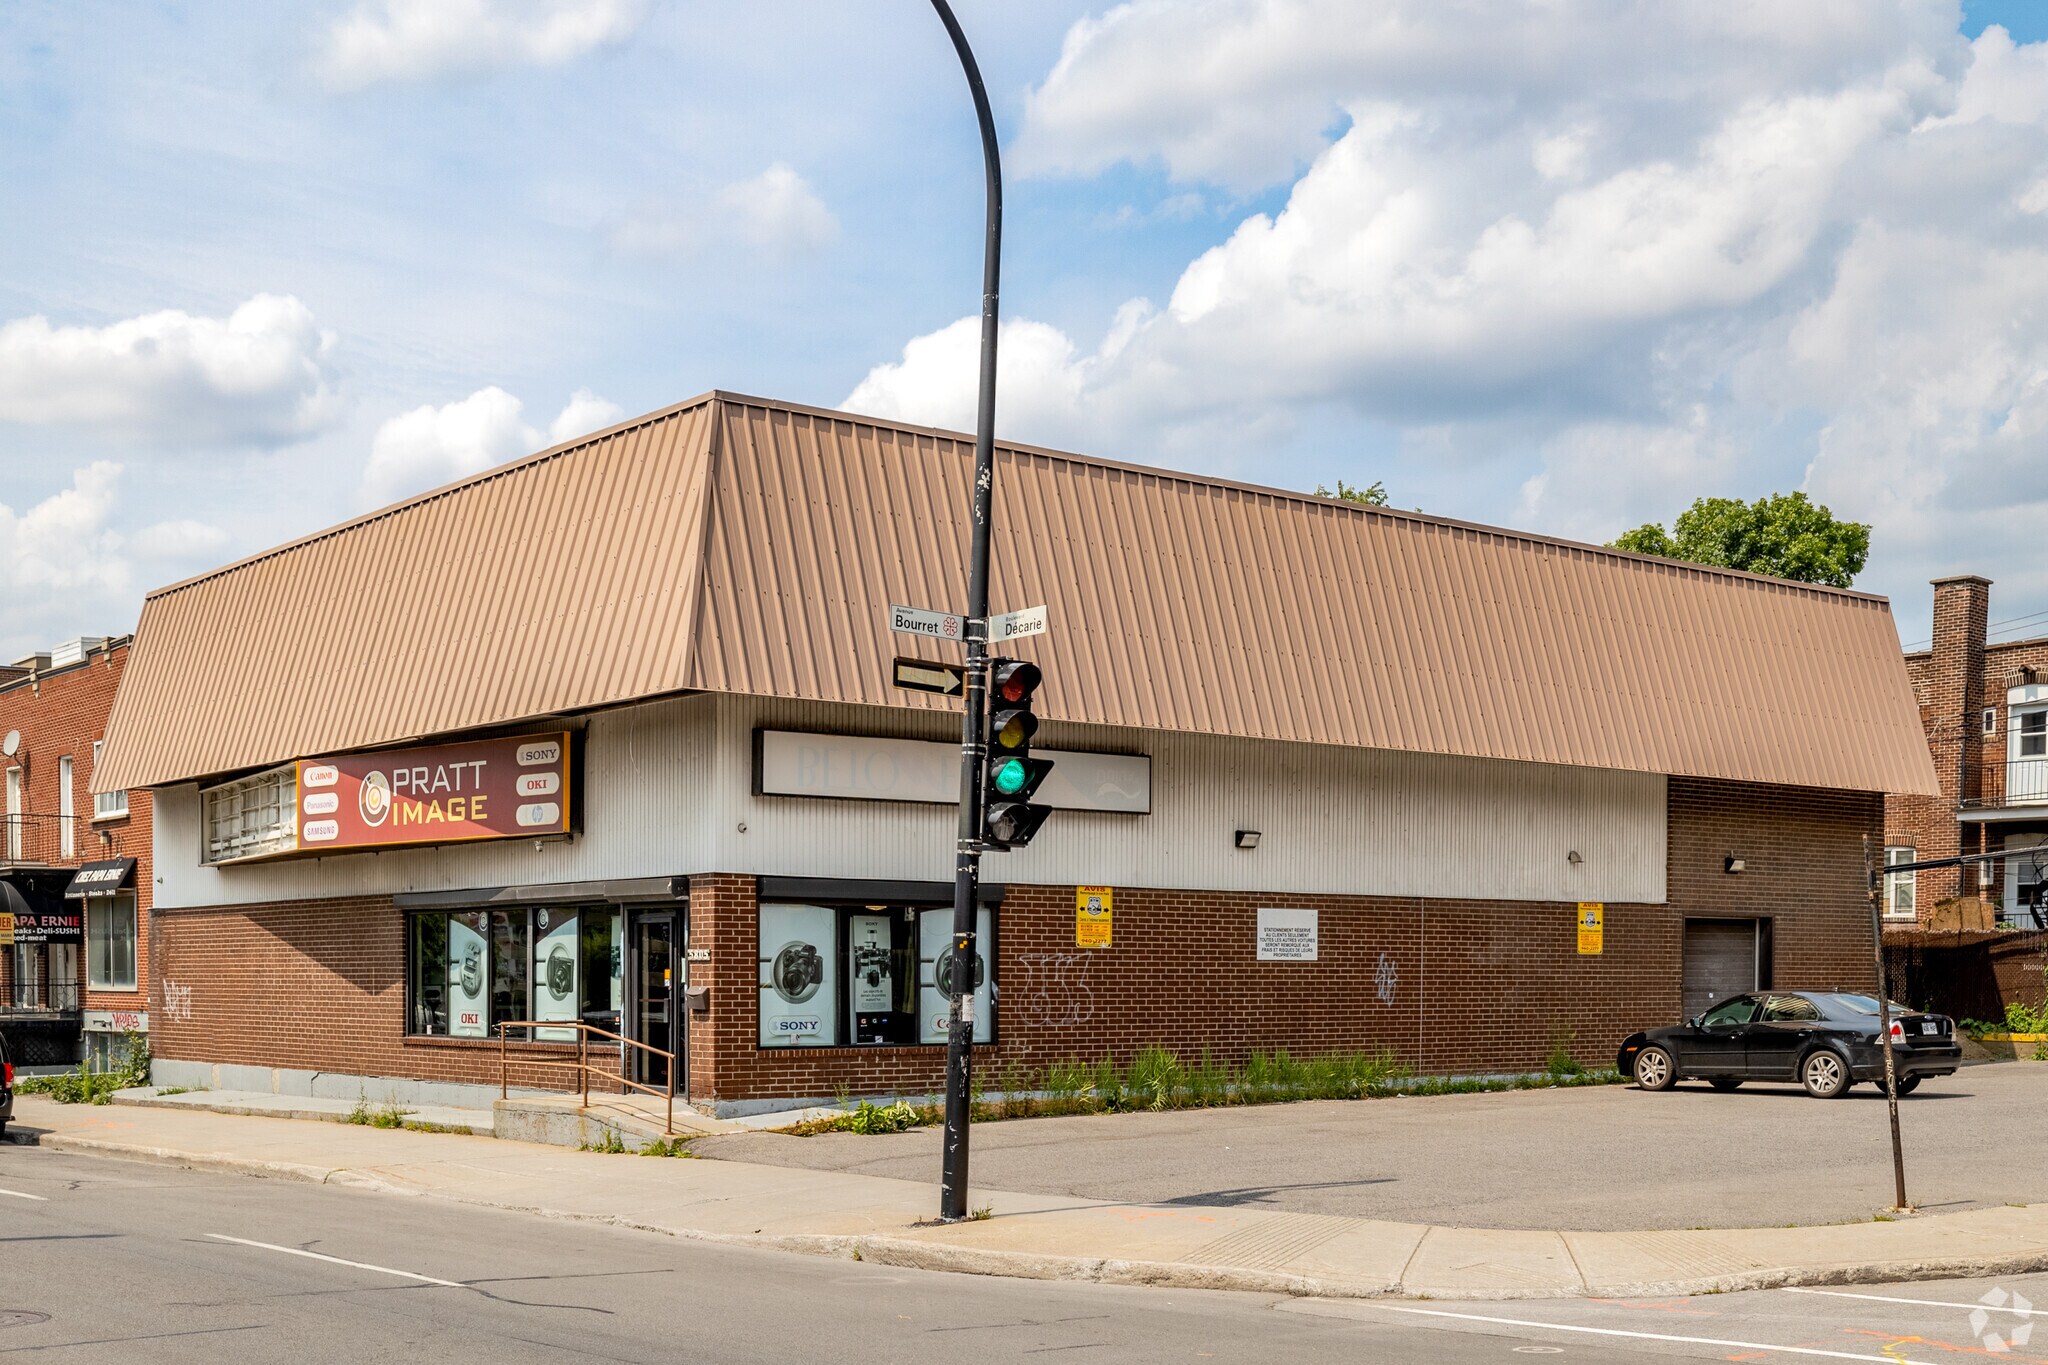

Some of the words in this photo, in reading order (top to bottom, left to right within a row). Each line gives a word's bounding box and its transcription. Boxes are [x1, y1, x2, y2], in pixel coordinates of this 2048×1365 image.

[896, 614, 939, 634] Bourret
[1005, 618, 1042, 636] Décarie
[526, 749, 557, 761] SONY
[310, 771, 333, 781] Canon
[393, 760, 487, 797] PRATT
[527, 779, 548, 790] OKI
[306, 801, 335, 810] Panasonic
[393, 795, 488, 827] IMAGE
[307, 826, 335, 836] SAMSUNG
[75, 871, 93, 884] CHEZ
[89, 869, 107, 882] PAPA
[104, 868, 124, 881] ERNIE
[14, 915, 37, 927] APA
[41, 915, 80, 927] ERNIE
[688, 950, 709, 960] 5805
[461, 1013, 479, 1024] OKI
[780, 1021, 818, 1030] SONY
